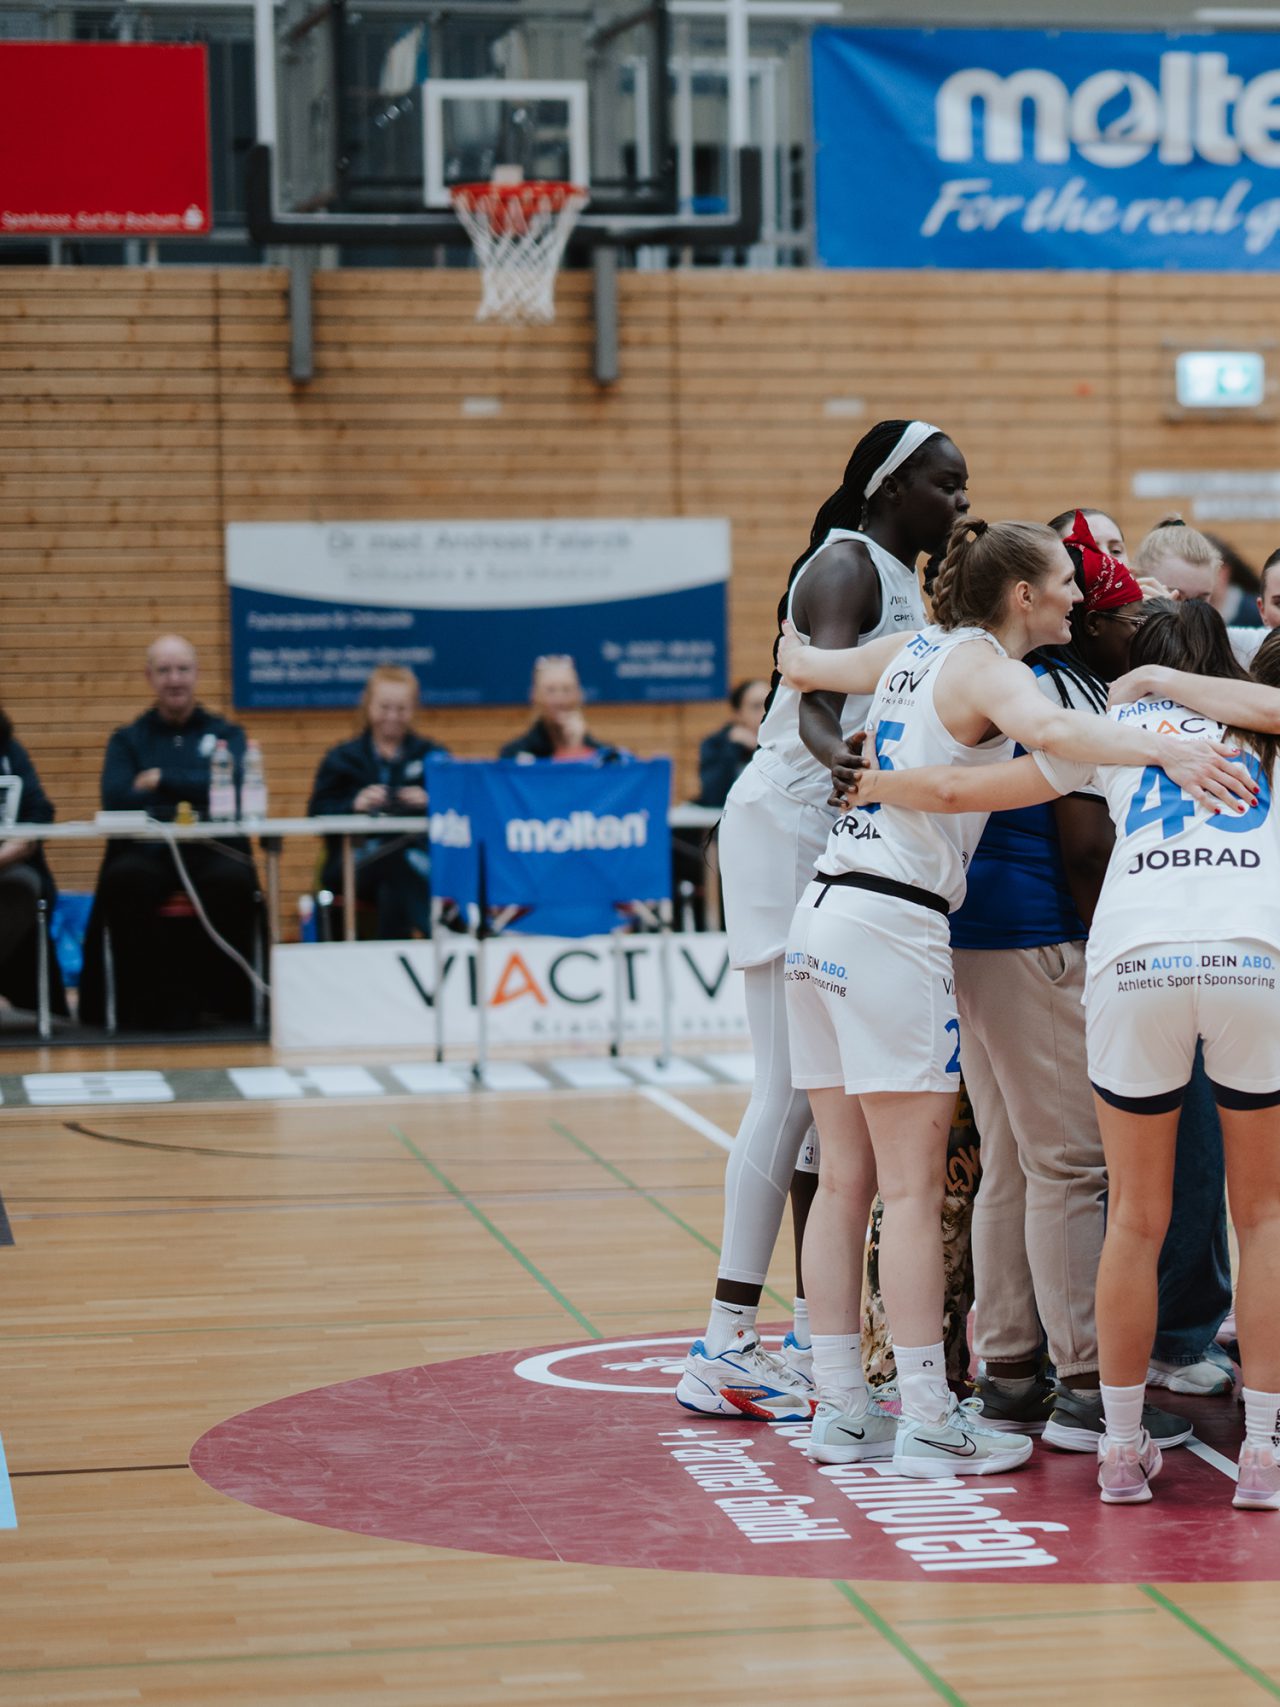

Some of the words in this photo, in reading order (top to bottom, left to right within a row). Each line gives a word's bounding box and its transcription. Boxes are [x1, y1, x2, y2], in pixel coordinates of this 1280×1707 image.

[920, 179, 1024, 237] For
[1022, 176, 1118, 234] the
[1122, 178, 1252, 234] real
[506, 811, 648, 852] molten
[1128, 848, 1261, 875] JOBRAD
[1116, 959, 1146, 975] DEIN
[1201, 955, 1237, 967] DEIN
[1242, 956, 1275, 970] ABO.
[1118, 977, 1164, 992] Athletic
[1167, 975, 1202, 988] Sport
[1204, 973, 1276, 990] Sponsoring
[662, 1438, 783, 1492] Partner
[714, 1495, 852, 1544] GmbH
